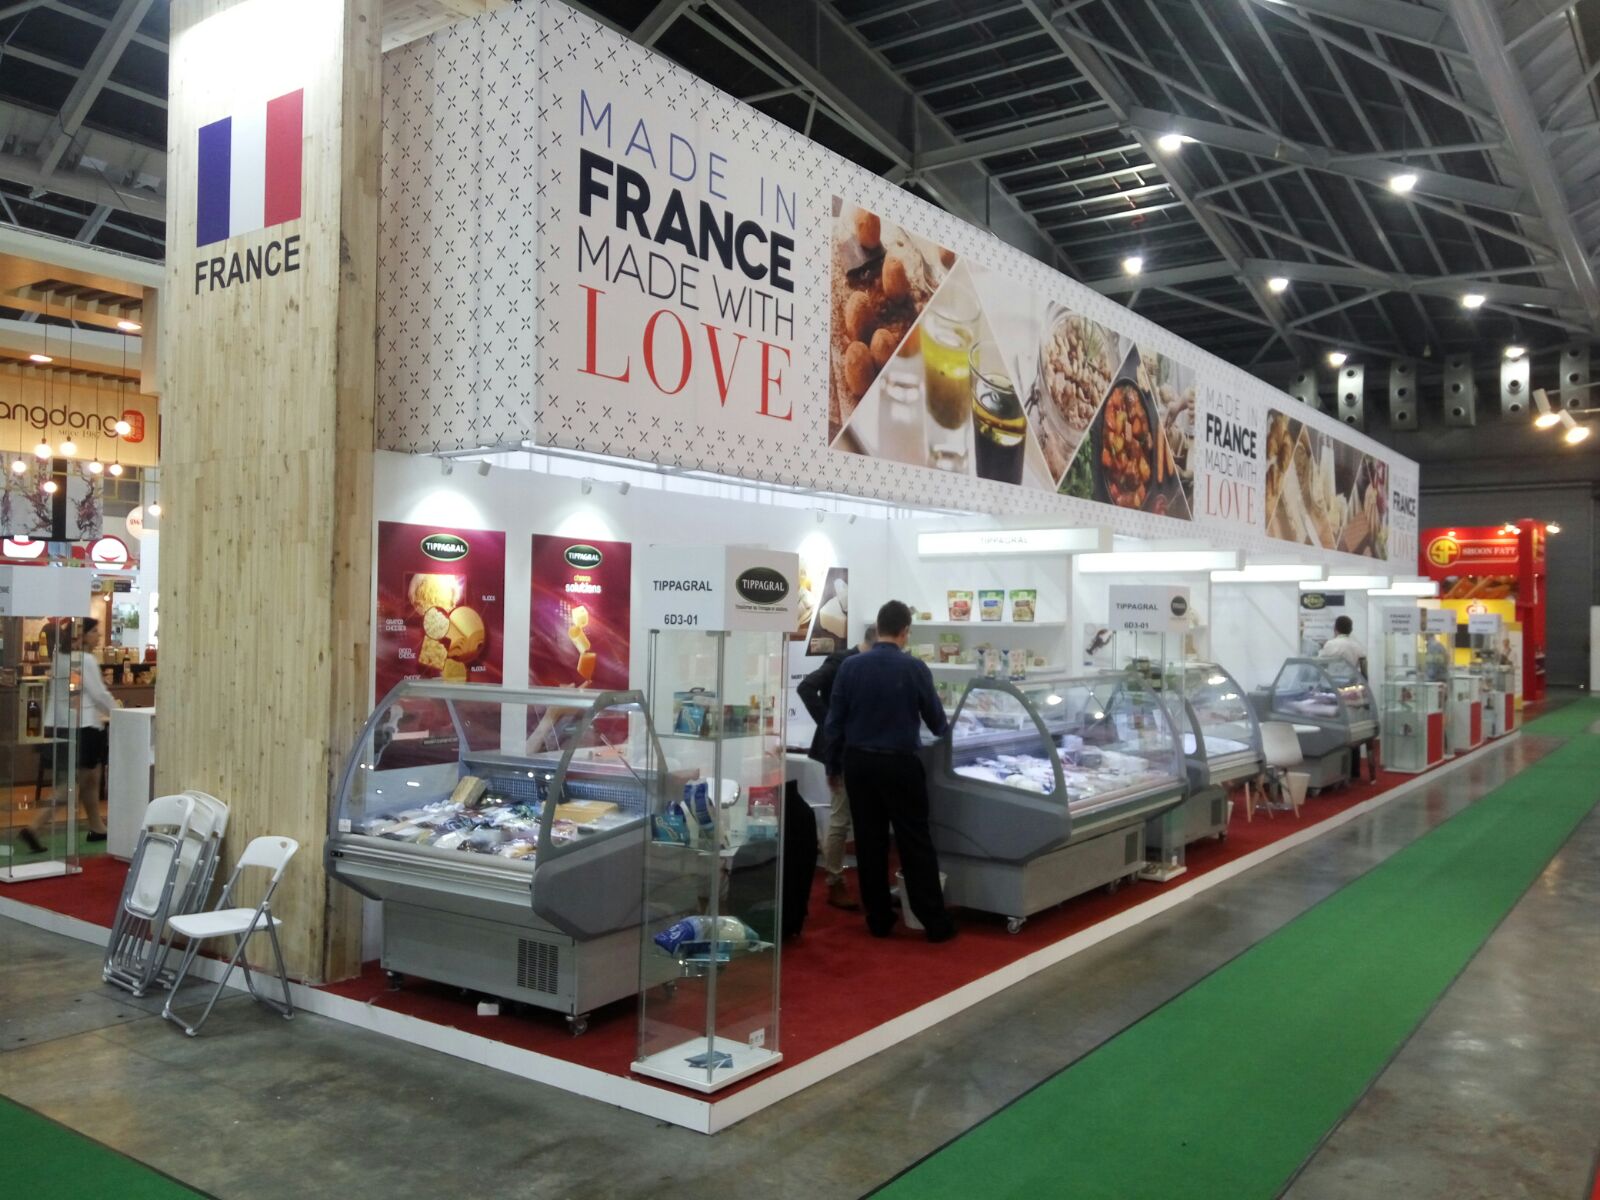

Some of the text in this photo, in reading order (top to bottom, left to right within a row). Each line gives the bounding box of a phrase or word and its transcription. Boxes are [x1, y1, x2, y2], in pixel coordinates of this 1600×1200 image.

[578, 88, 796, 231] MADE IN
[579, 147, 795, 294] FRANCE
[195, 234, 300, 296] FRANCE
[578, 225, 794, 341] MADE WITH
[577, 283, 793, 421] LOVE
[1206, 386, 1240, 421] MADE
[1206, 412, 1257, 460] FRANCE
[1205, 448, 1257, 484] MADE WITH
[1205, 473, 1257, 525] LOVE
[1393, 490, 1416, 517] FRANCE
[426, 541, 465, 554] TIPPAGRAL
[568, 551, 599, 561] TIPPAGRAL
[653, 580, 713, 592] TIPPAGRAL
[742, 578, 785, 592] TIPPAGRAL
[664, 614, 698, 625] 6D3-01
[1116, 603, 1159, 611] TIPPAGRAL
